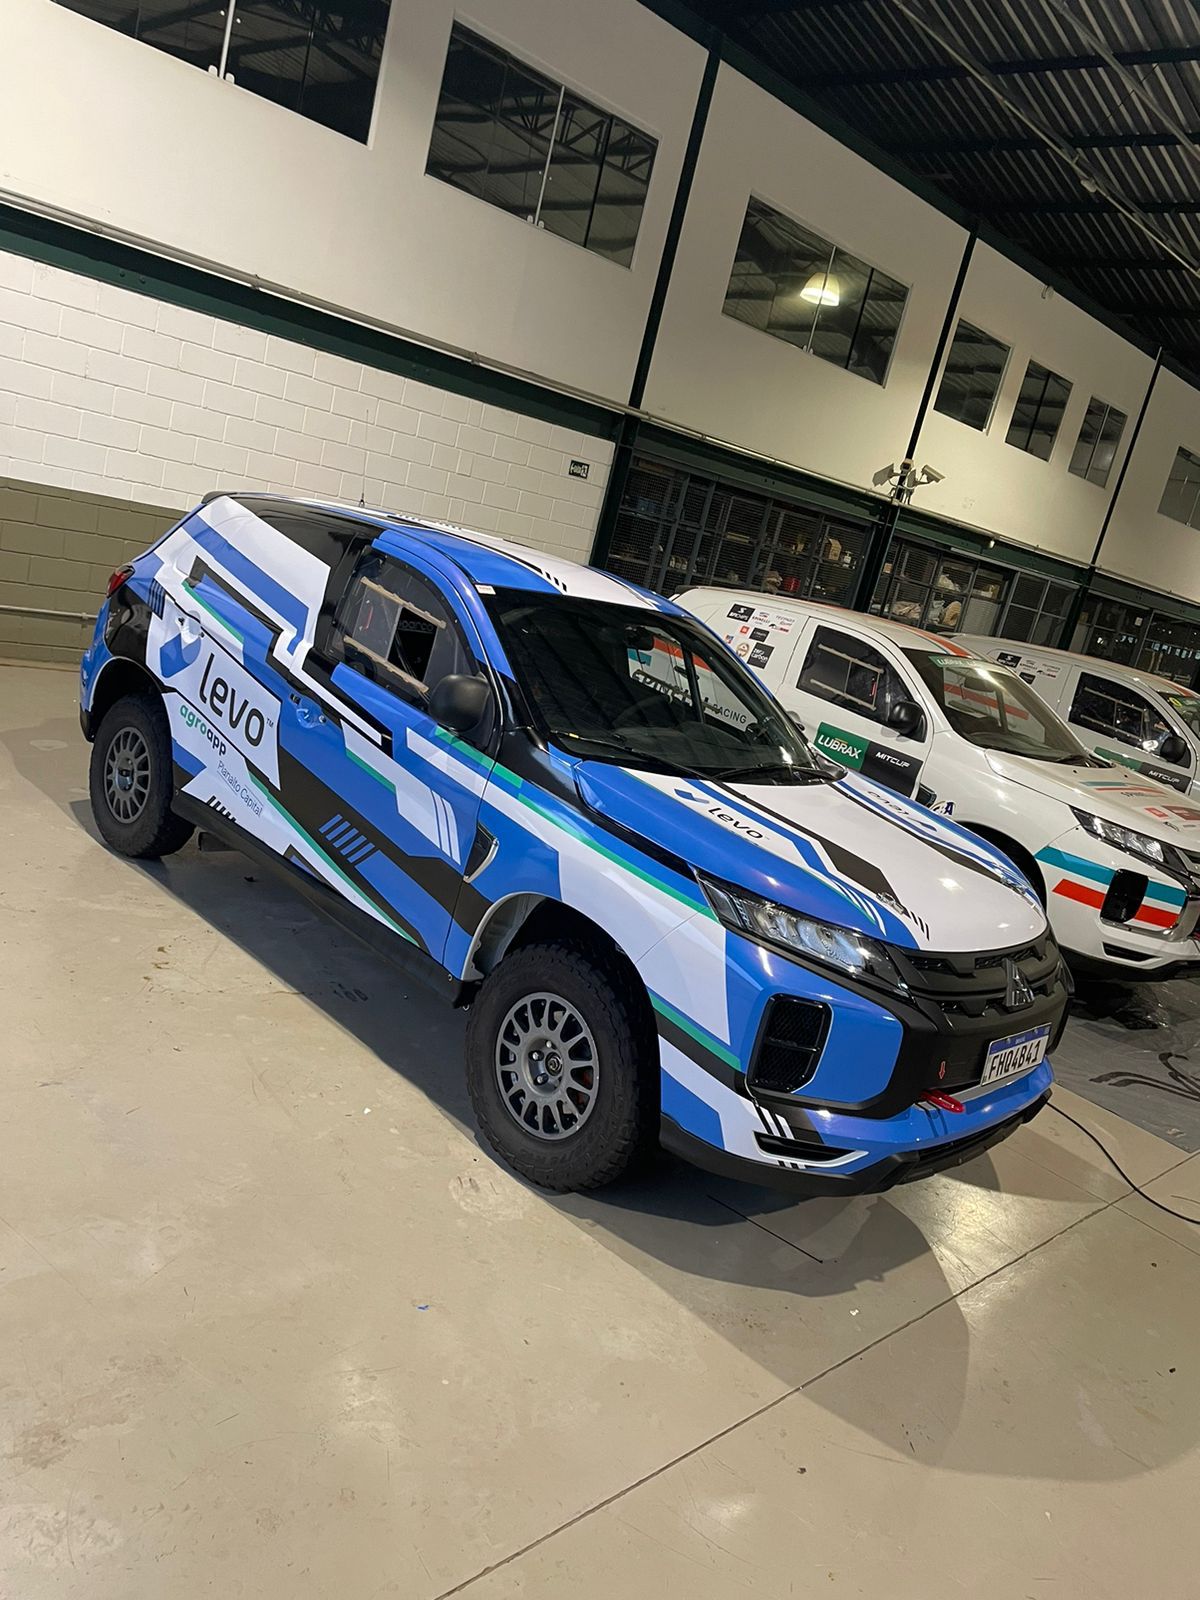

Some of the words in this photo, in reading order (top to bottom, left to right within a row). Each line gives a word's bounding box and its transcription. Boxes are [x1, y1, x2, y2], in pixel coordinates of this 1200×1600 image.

[198, 652, 265, 747] levo
[180, 704, 227, 756] agroapp
[818, 734, 862, 759] LUBRAX
[876, 751, 910, 768] MITCUP
[218, 760, 241, 795] Planalto
[240, 788, 264, 816] Capital
[1149, 770, 1180, 783] MITCUP
[708, 807, 763, 839] levo
